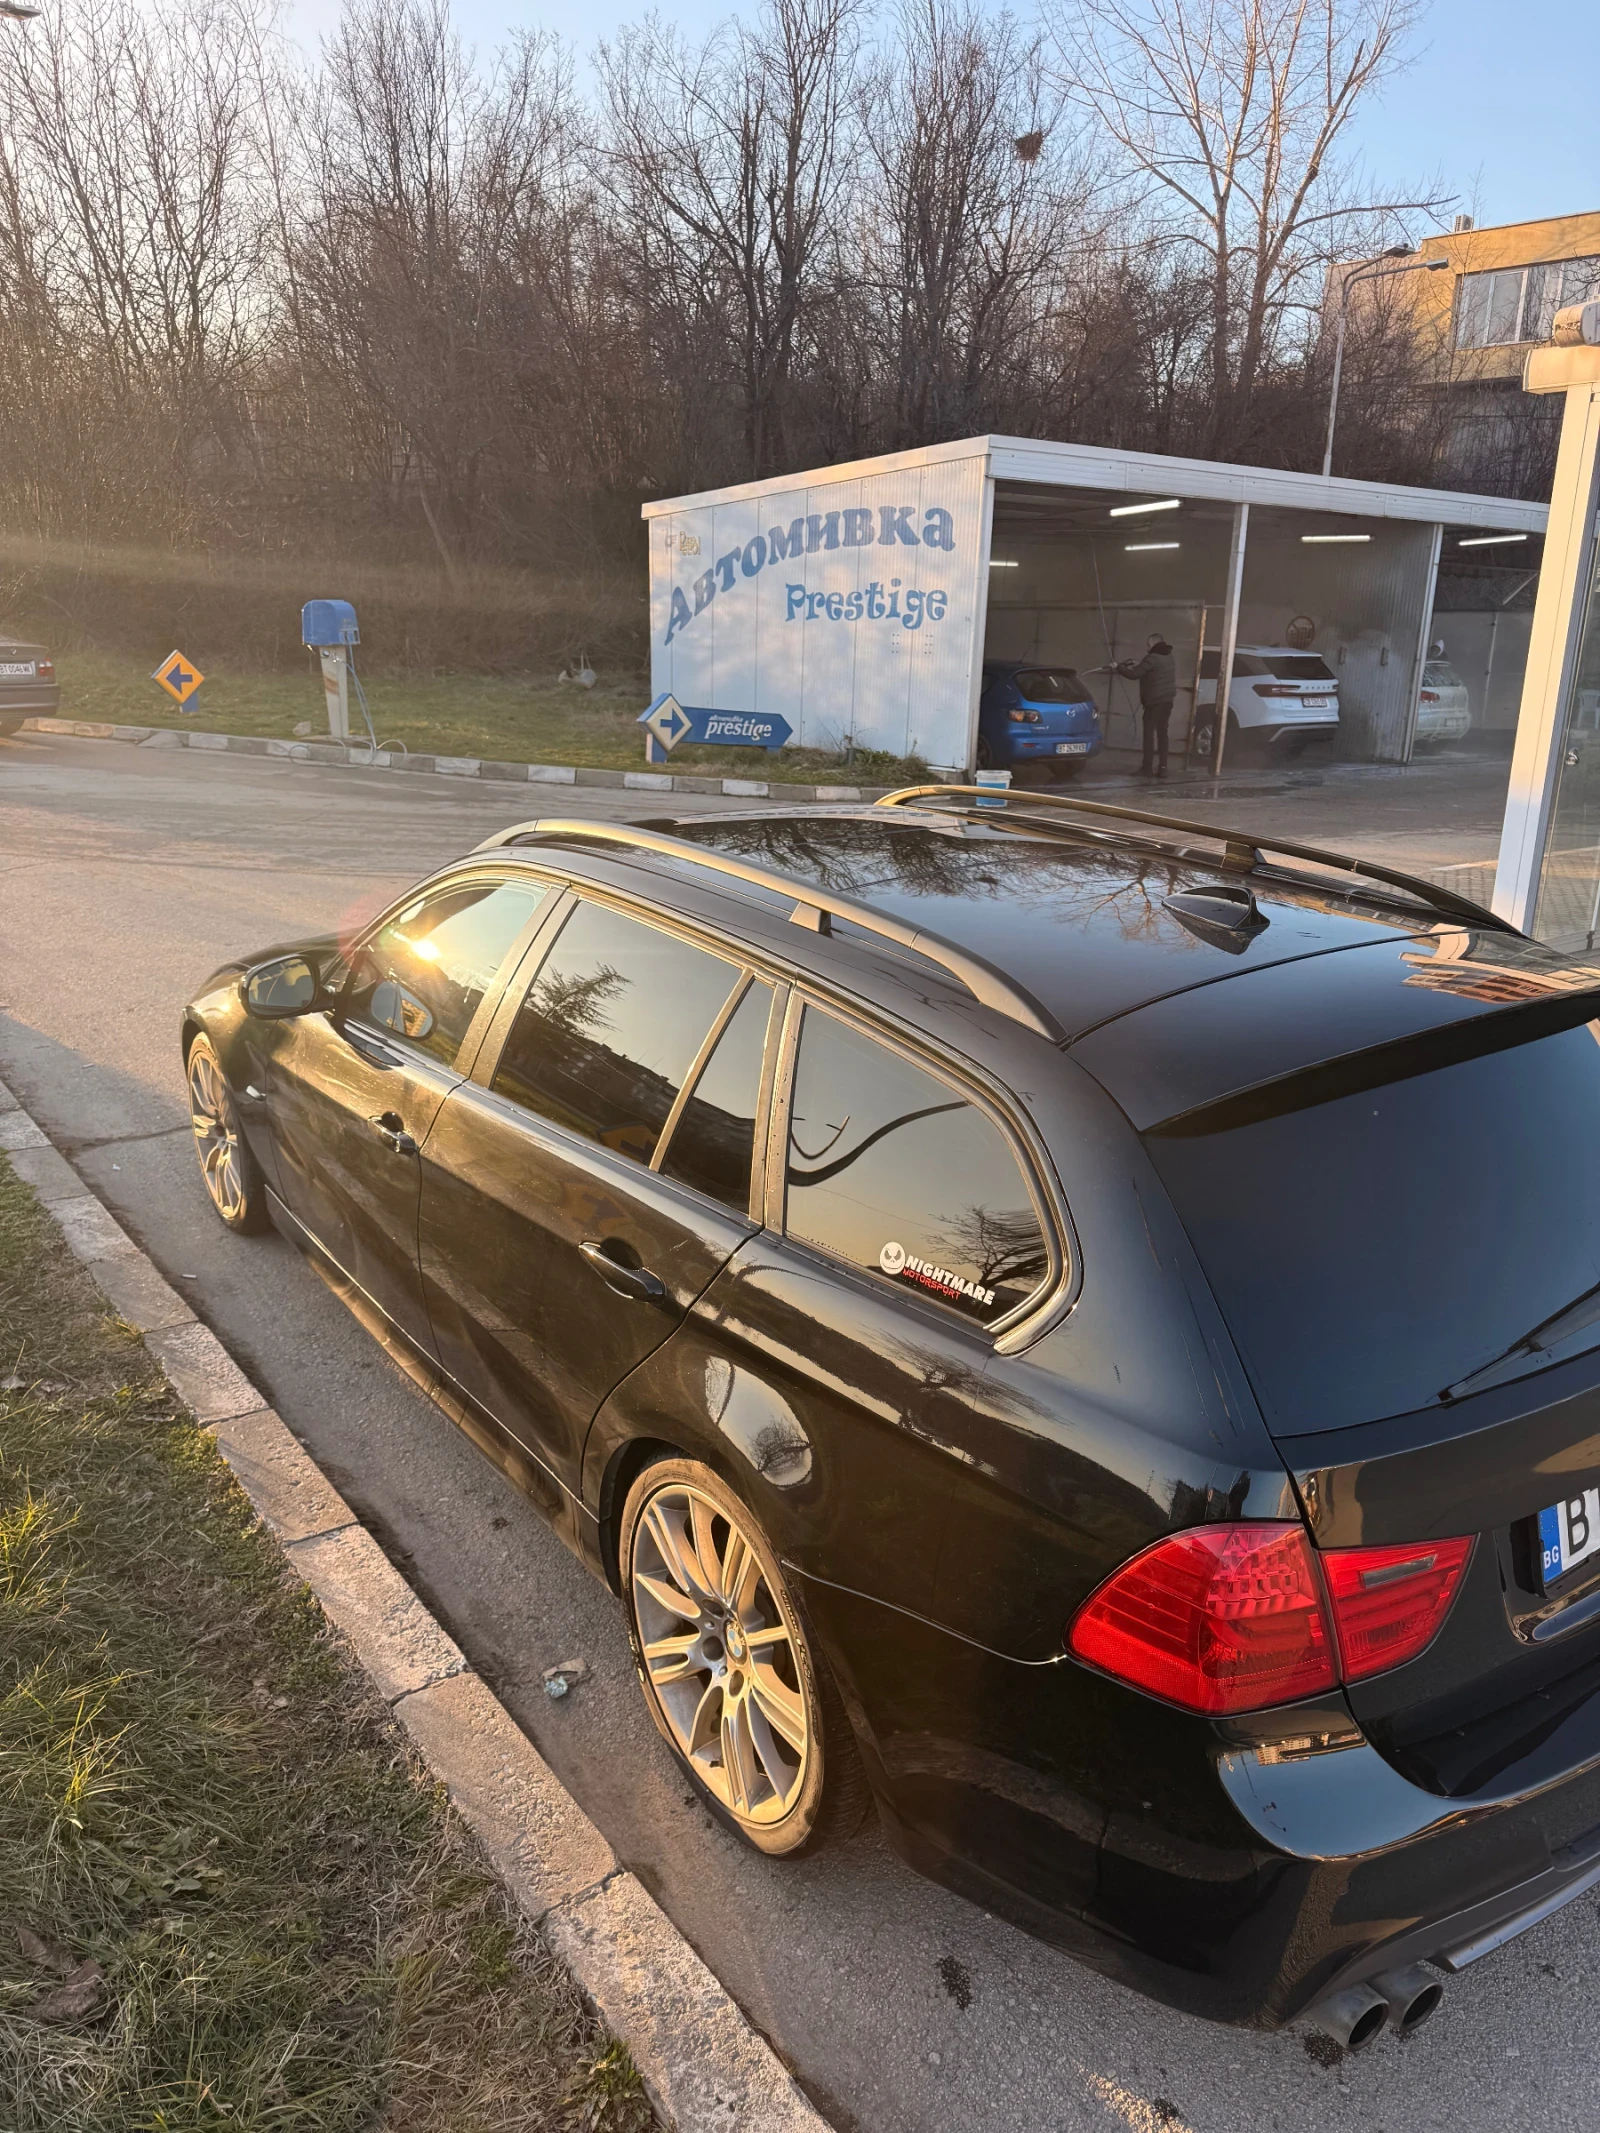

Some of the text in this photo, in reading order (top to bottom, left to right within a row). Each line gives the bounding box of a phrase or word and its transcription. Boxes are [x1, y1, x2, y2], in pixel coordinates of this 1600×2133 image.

[785, 578, 948, 630] Prestige
[704, 719, 773, 741] prestige
[903, 1267, 961, 1300] MOTORSPORT
[905, 1255, 996, 1305] NIGHTMARE
[1544, 1545, 1560, 1569] BG
